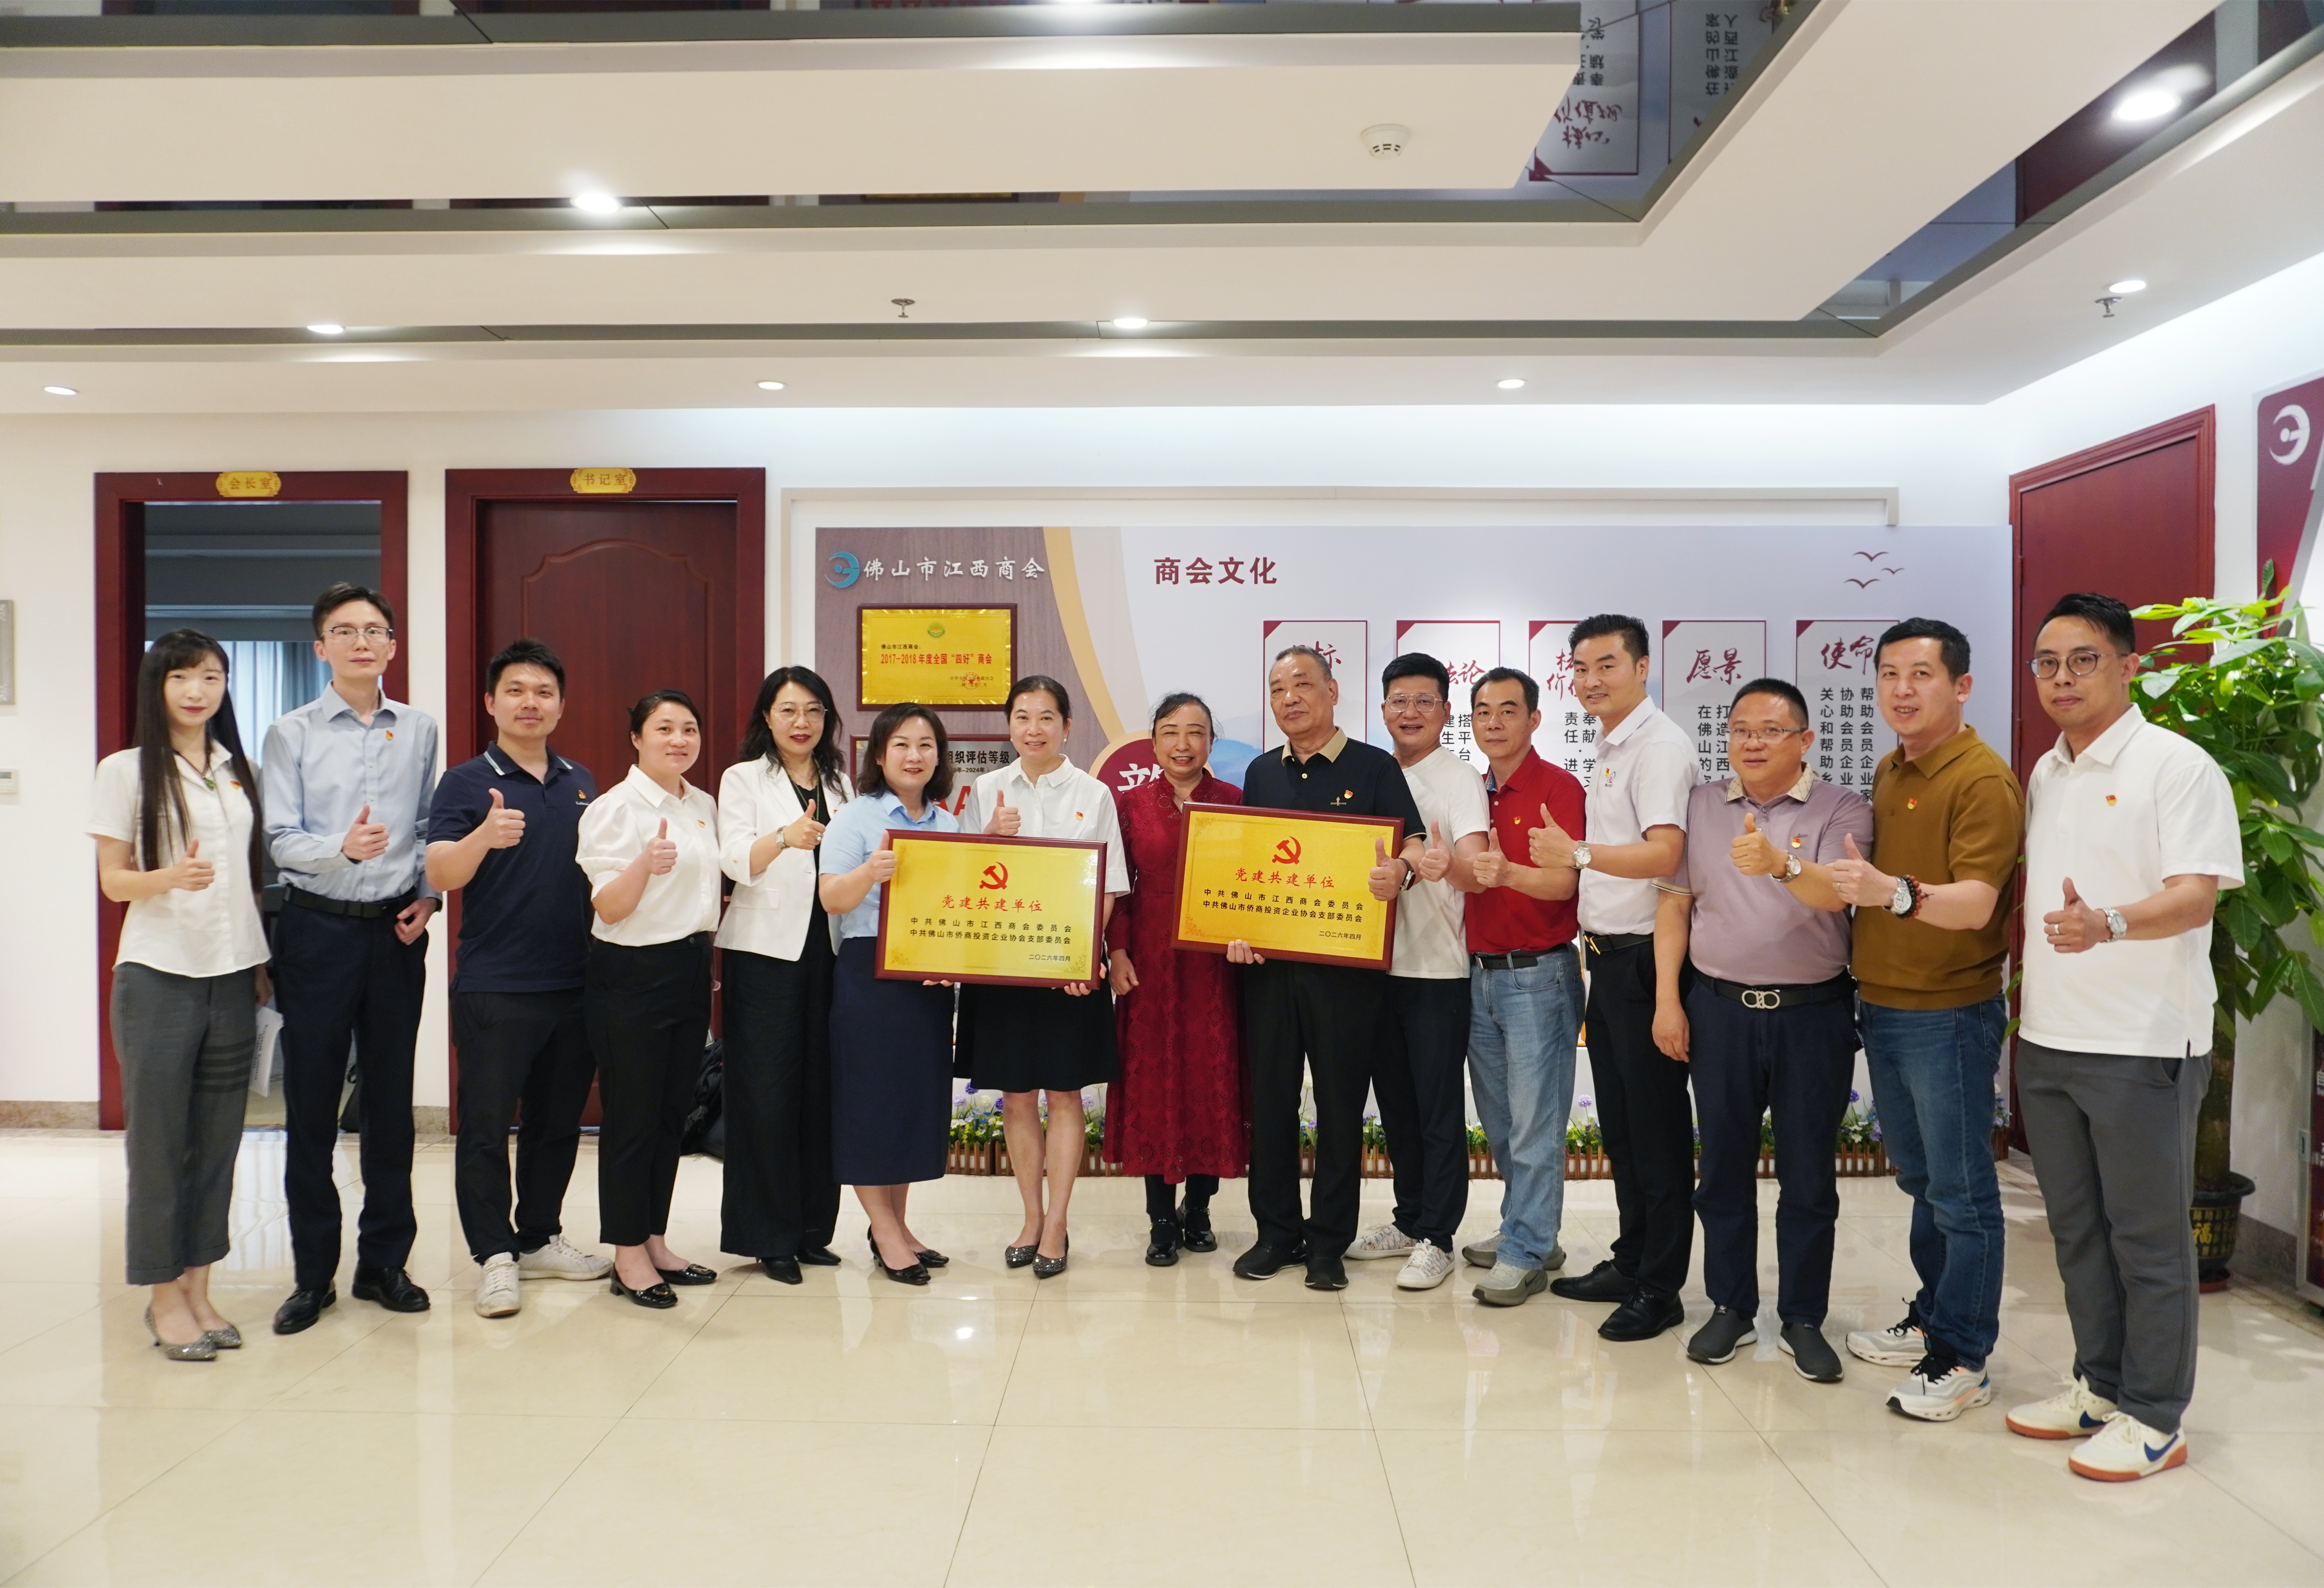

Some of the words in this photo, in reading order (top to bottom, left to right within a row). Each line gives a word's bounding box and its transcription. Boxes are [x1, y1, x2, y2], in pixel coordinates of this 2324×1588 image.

[229, 477, 272, 489] 会长室
[583, 473, 626, 486] 书记室
[863, 556, 1045, 581] 佛山市江西商会
[1154, 557, 1278, 584] 商会文化
[1686, 648, 1742, 685] 愿景
[1821, 636, 1874, 675] 使命
[1441, 715, 1455, 752] 建生
[1458, 714, 1471, 761] 搭平台
[1840, 687, 1854, 785] 协助会员企业
[1860, 687, 1874, 803] 帮助会员企业家
[1235, 867, 1335, 889] 党建共建单位
[942, 894, 1043, 913] 党建共建单位
[1202, 900, 1363, 923] 中共佛山市侨商投资企业协会支部委员会
[1204, 888, 1363, 911] 中共佛山市江西商会委员会
[910, 917, 1071, 933] 中共佛山市江西商会委员会
[910, 929, 1071, 944] 中共佛山市侨商投资企业协会支部委员会
